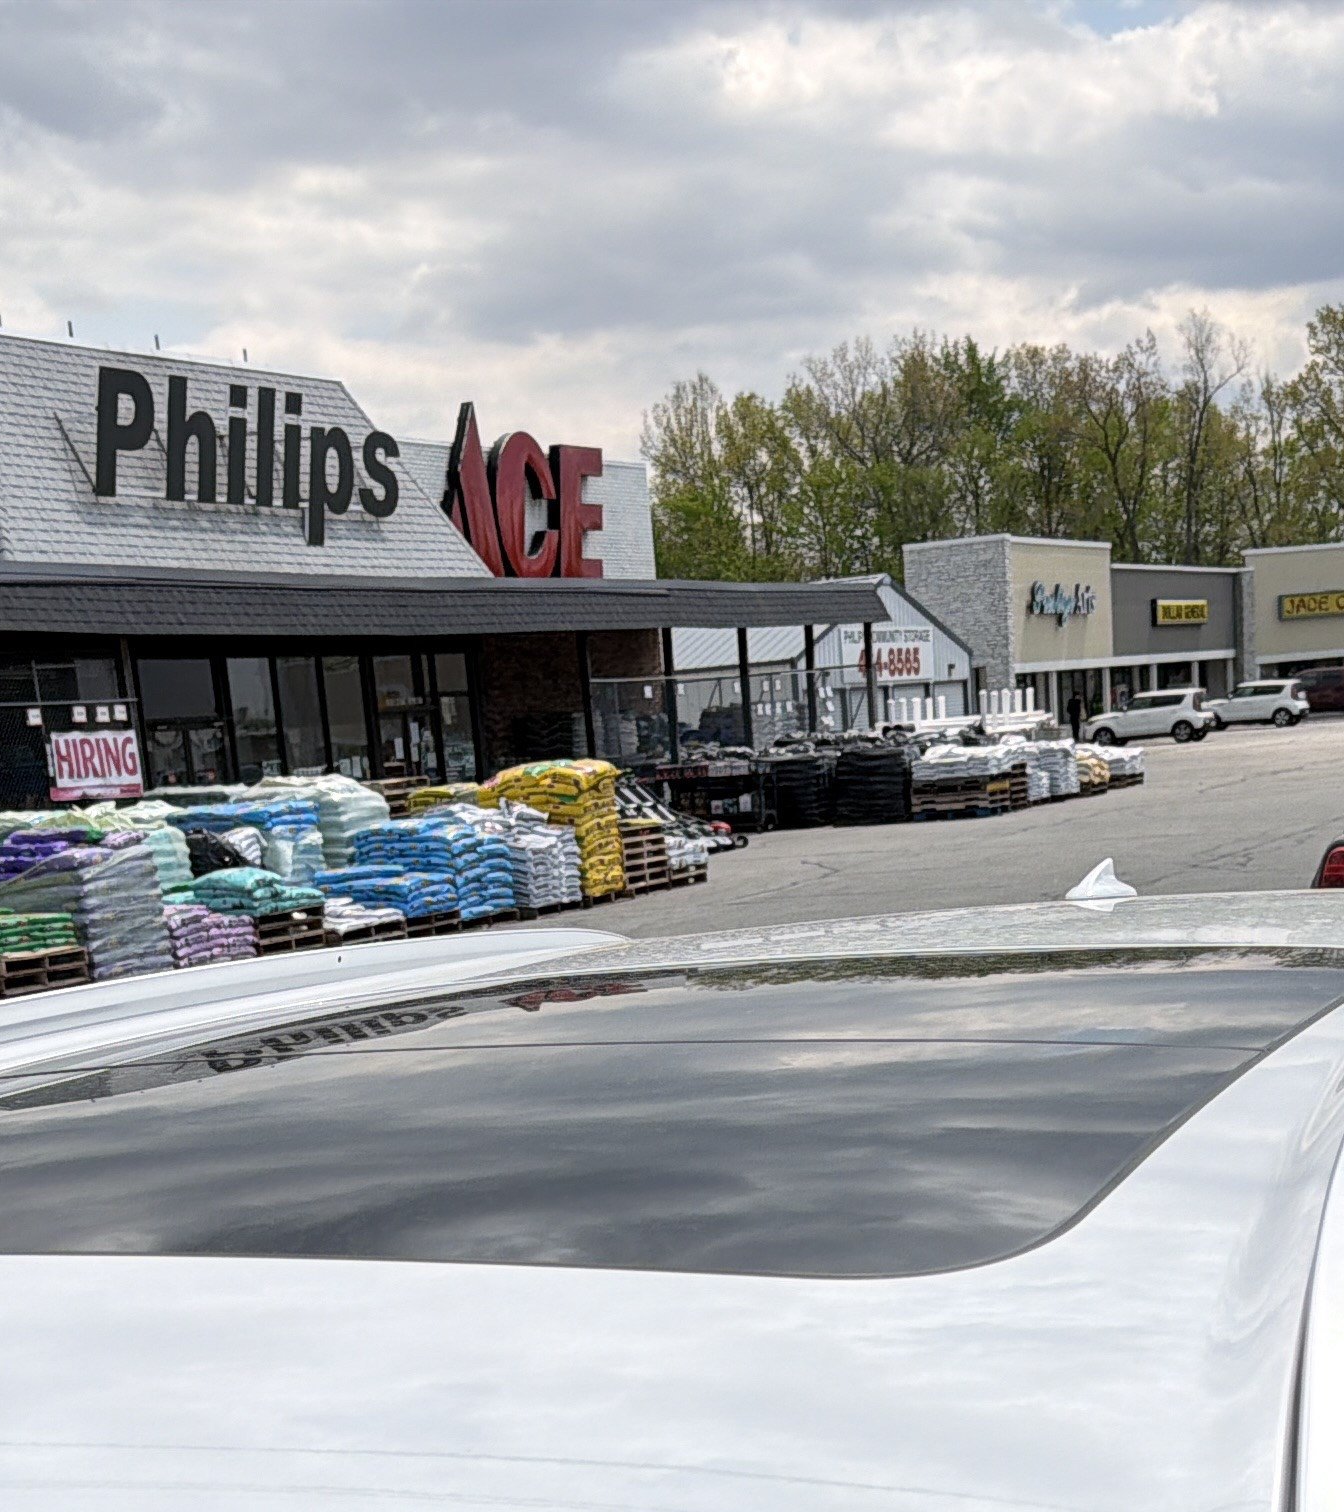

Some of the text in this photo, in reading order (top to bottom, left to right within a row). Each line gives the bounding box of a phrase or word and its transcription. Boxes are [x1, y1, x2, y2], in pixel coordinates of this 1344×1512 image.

[96, 365, 401, 546] Philips
[441, 401, 604, 579] ACE
[1285, 594, 1330, 615] JADE
[54, 736, 138, 779] HIRING
